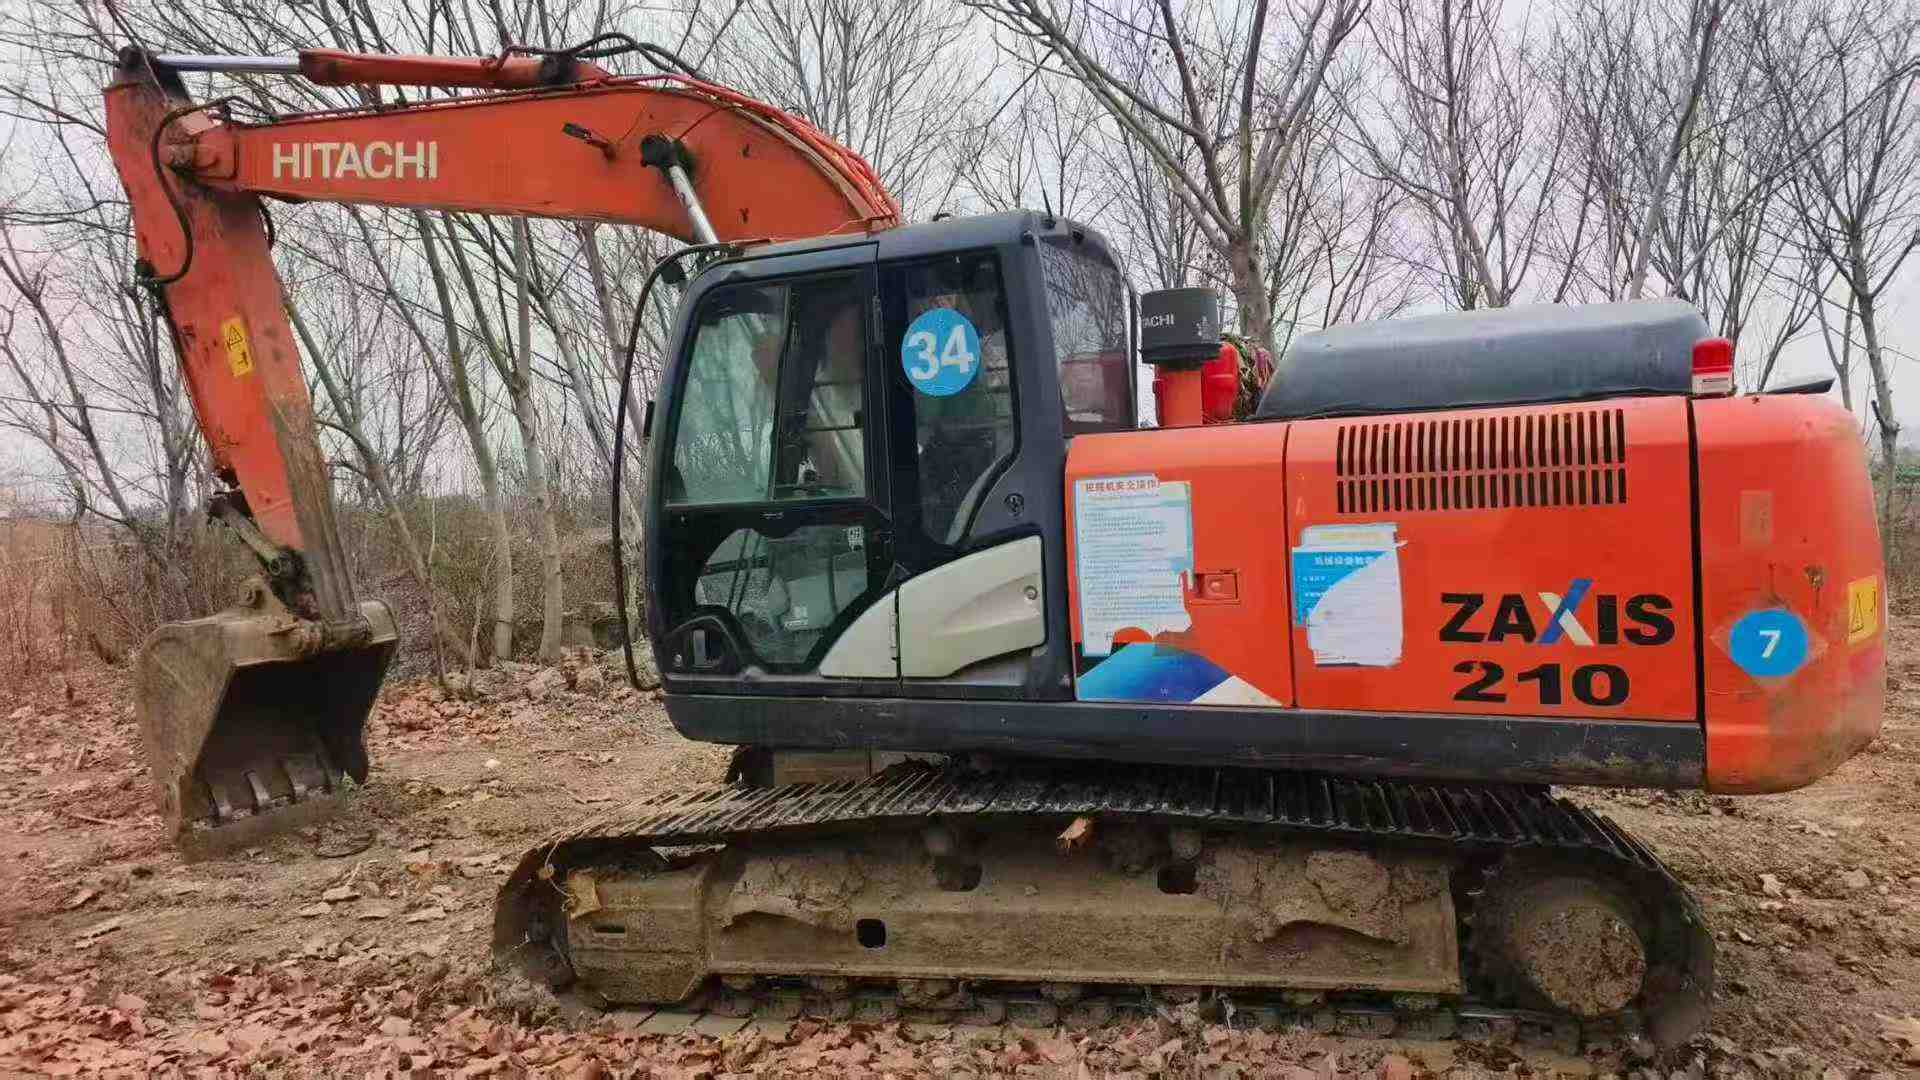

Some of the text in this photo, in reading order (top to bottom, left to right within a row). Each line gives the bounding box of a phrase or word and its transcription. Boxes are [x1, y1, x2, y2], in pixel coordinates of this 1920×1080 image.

[272, 140, 438, 180] HITACHI
[904, 323, 975, 380] 34
[1086, 479, 1160, 493] 挖掘机安全操作
[1439, 578, 1676, 646] ZAXIS
[1758, 629, 1782, 658] 7
[1452, 660, 1631, 707] 210
